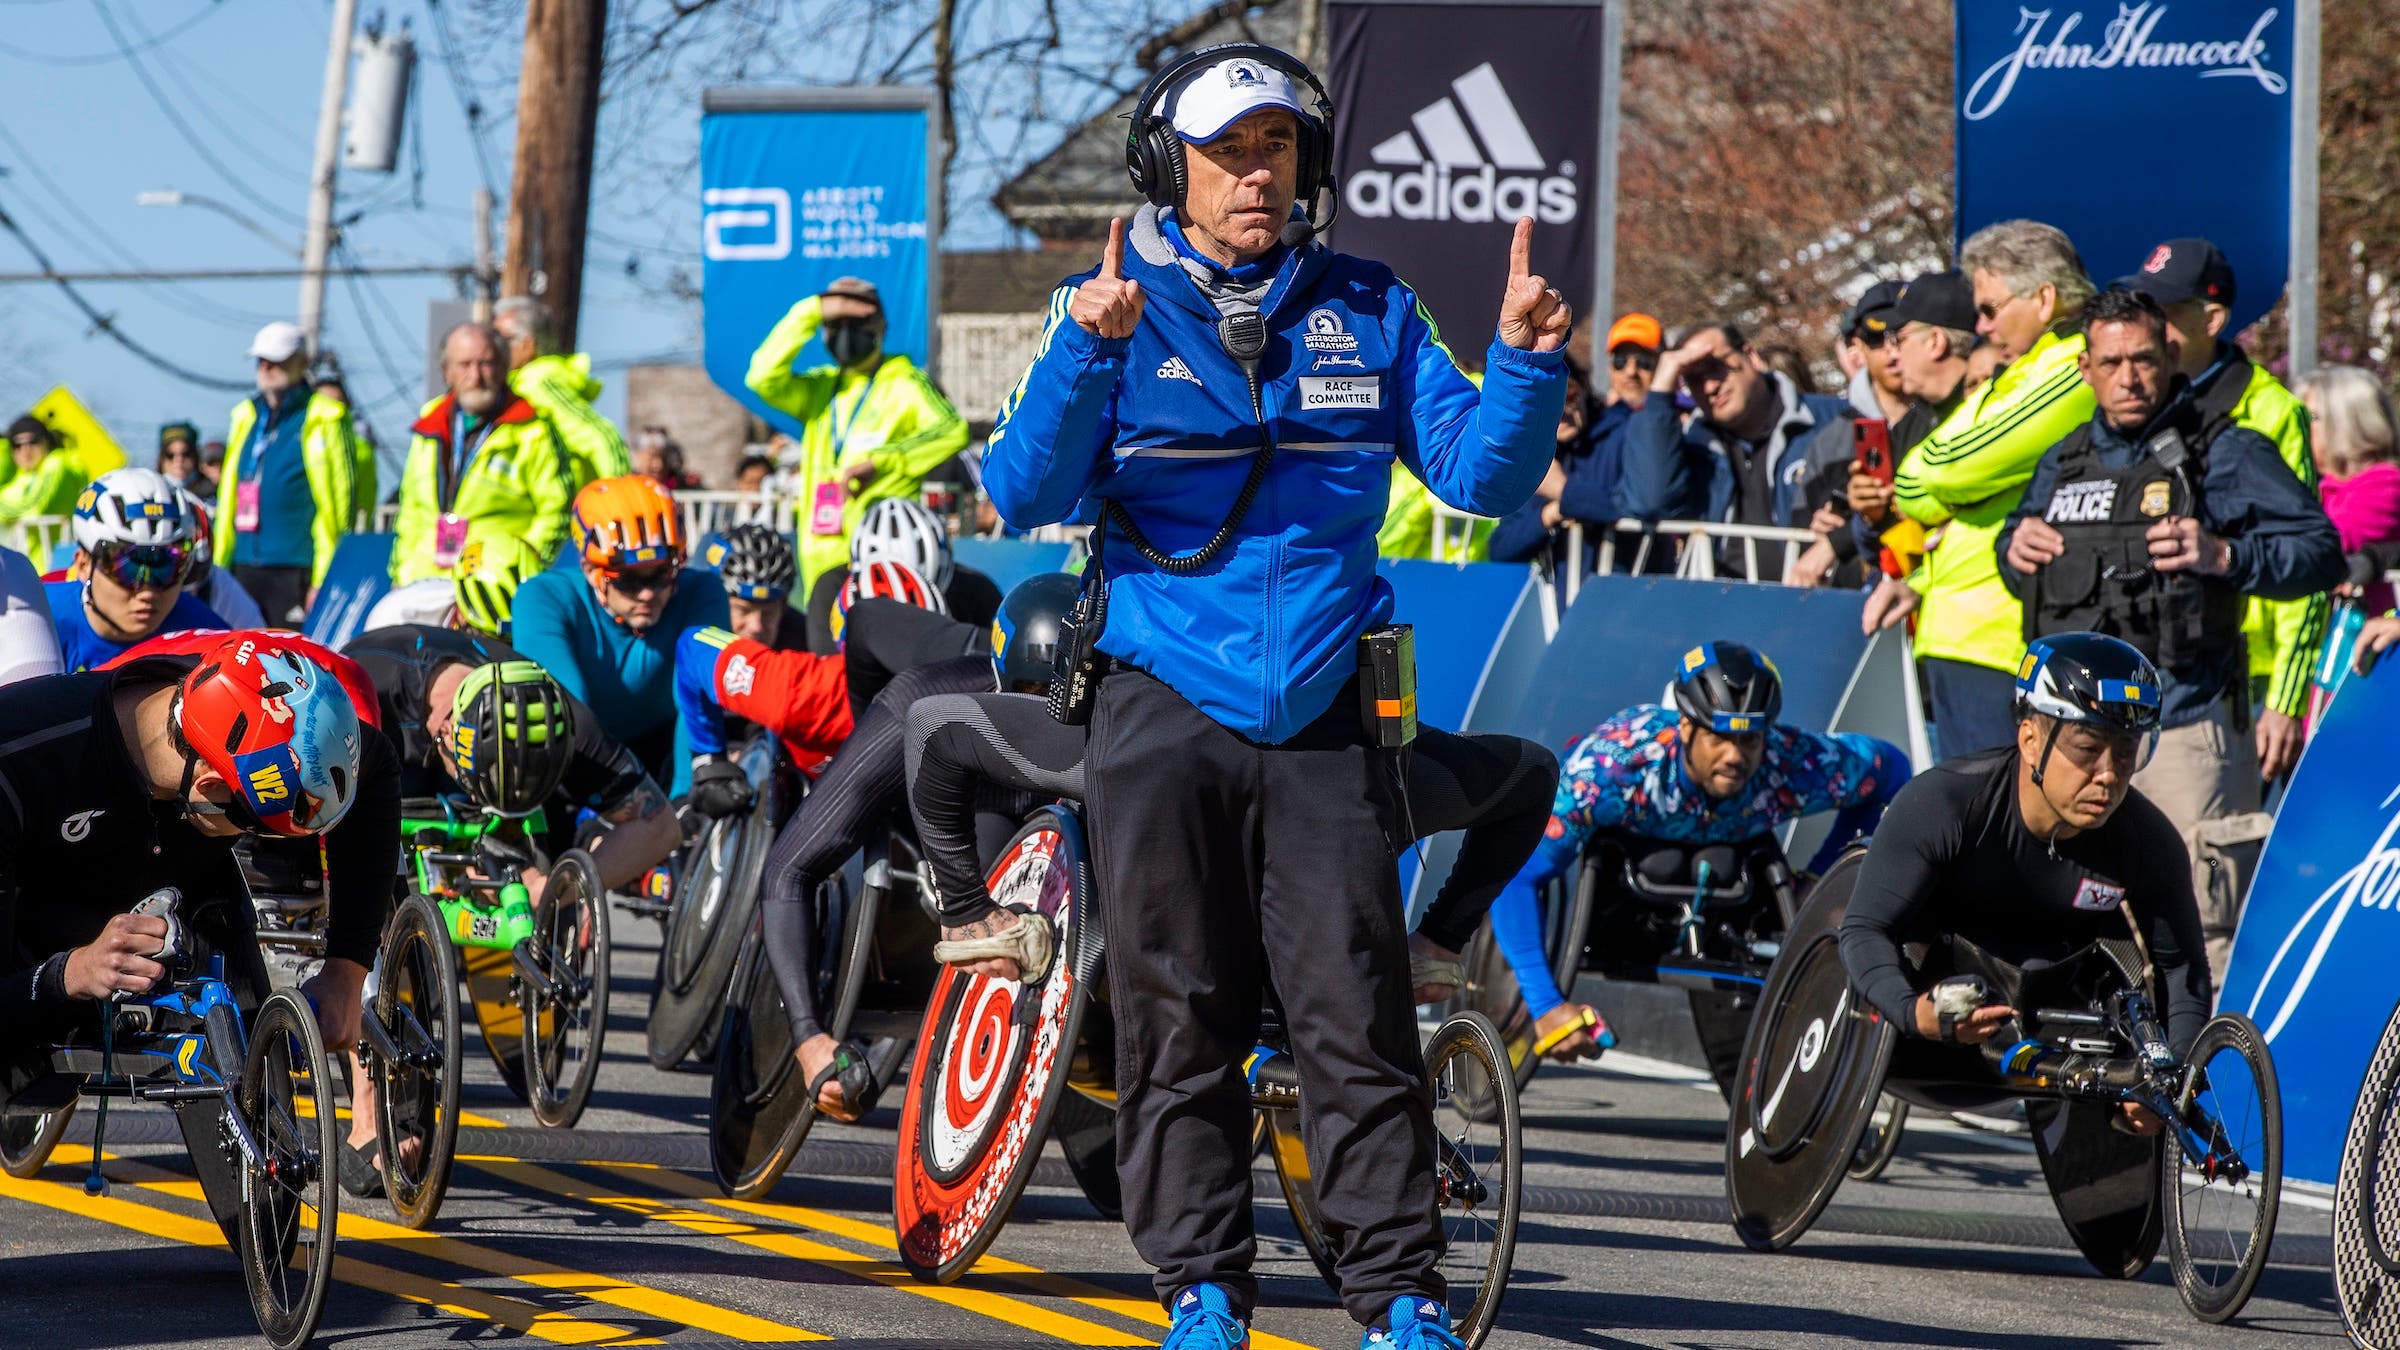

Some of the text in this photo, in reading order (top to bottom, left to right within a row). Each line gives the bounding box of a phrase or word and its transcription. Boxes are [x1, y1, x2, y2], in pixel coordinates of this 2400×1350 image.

[1963, 0, 2288, 121] John Hancock
[802, 187, 884, 205] ABBOTT
[1346, 160, 1577, 224] adidas
[802, 203, 879, 222] WORLD
[802, 222, 926, 241] MARATHON
[1322, 335, 1354, 343] BOSTON
[1325, 381, 1353, 391] RACE
[1308, 394, 1371, 404] COMMITTEE
[2045, 489, 2117, 522] POLICE
[234, 640, 256, 667] CLIF
[249, 763, 289, 804] W2
[226, 1110, 255, 1165] TOP END
